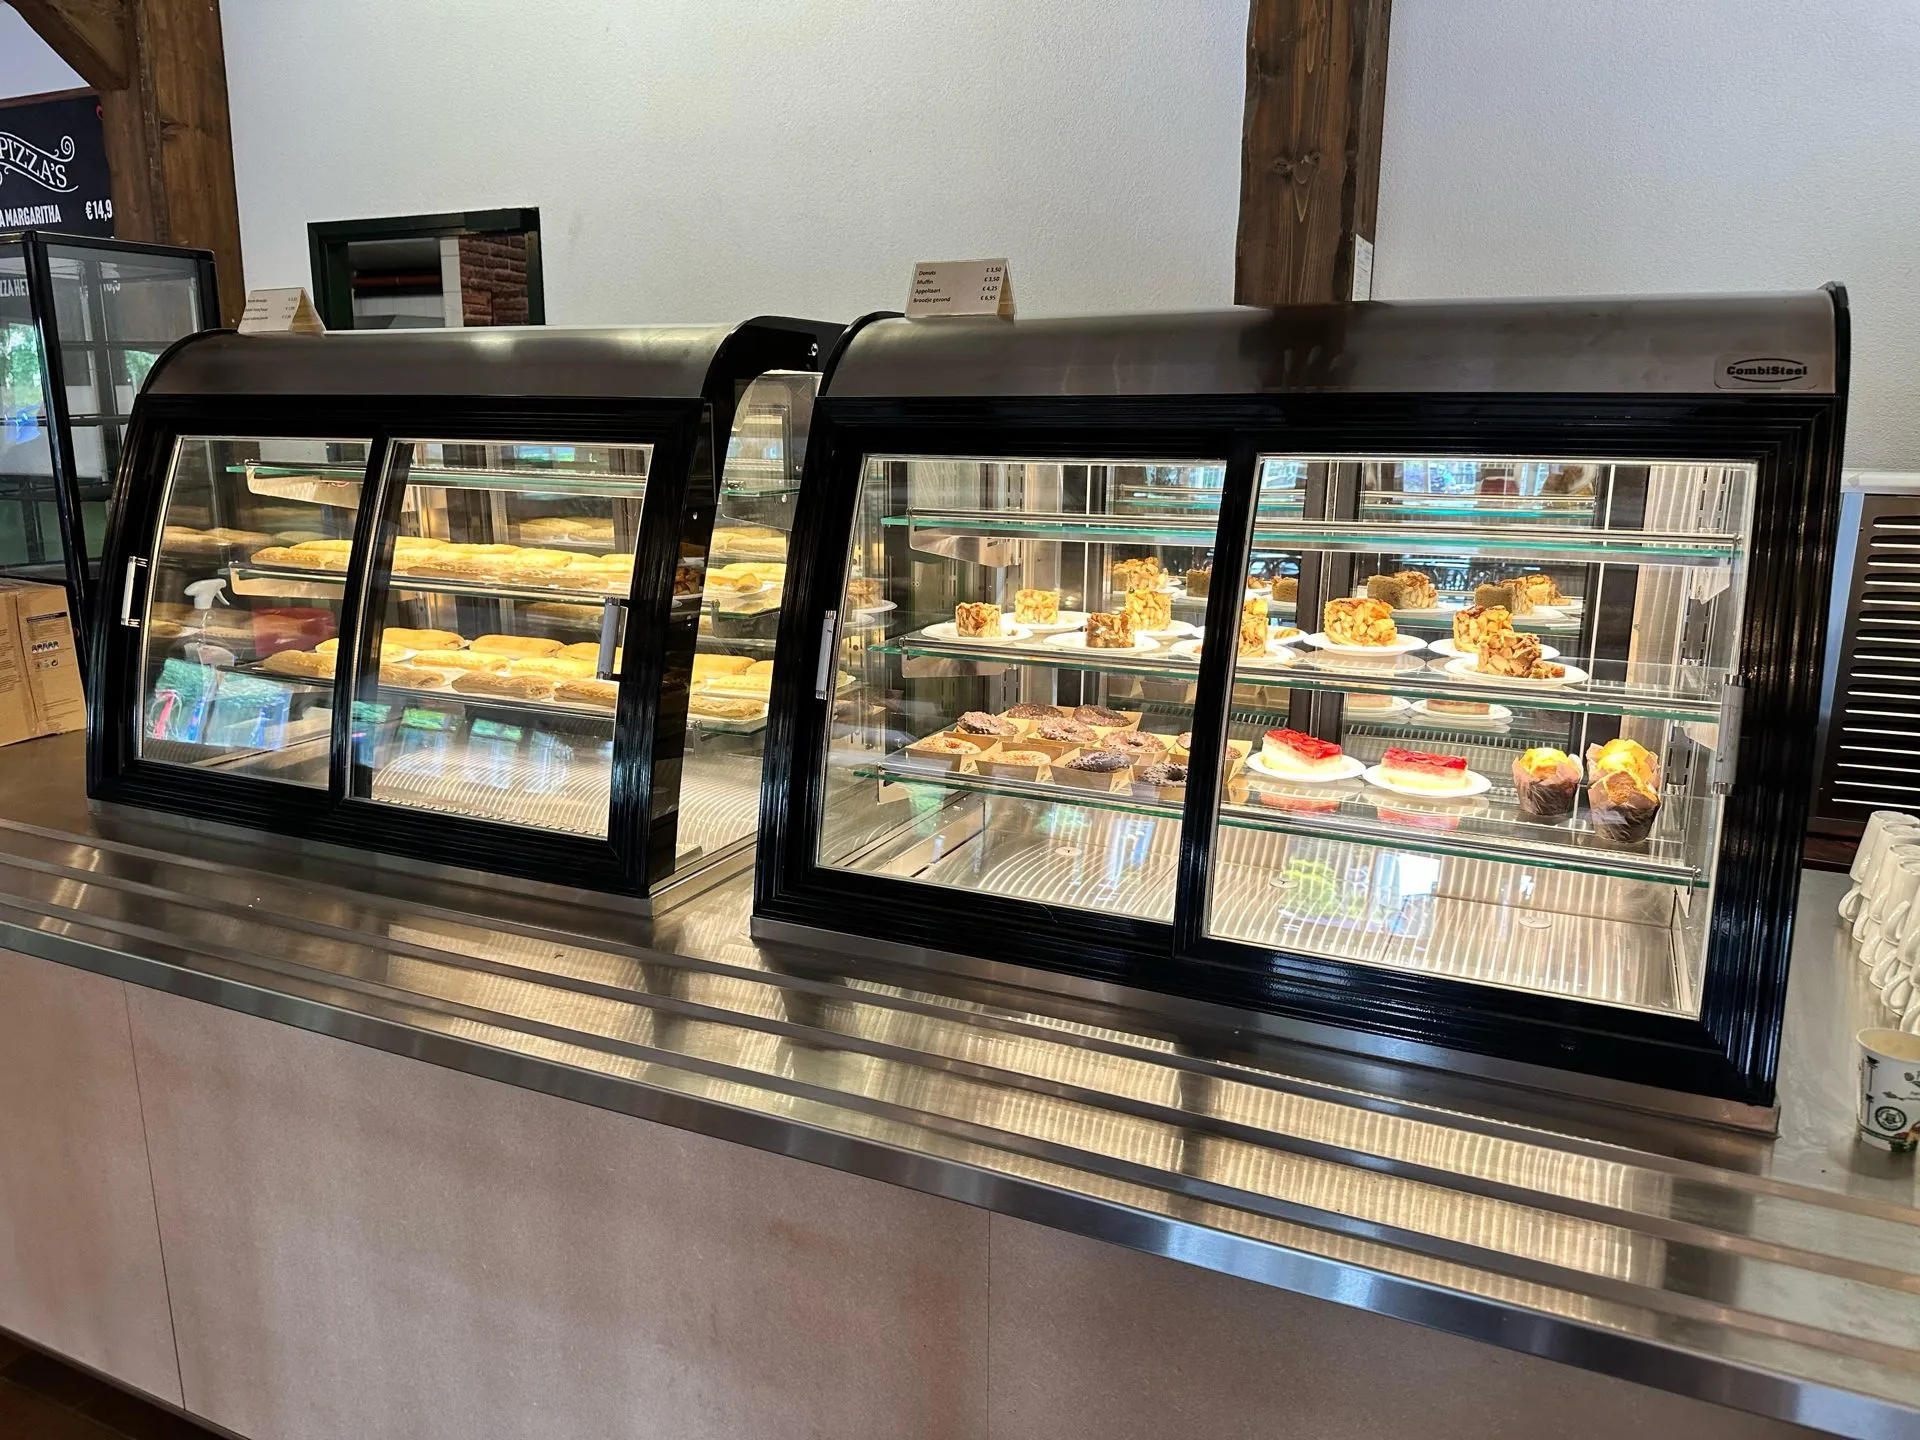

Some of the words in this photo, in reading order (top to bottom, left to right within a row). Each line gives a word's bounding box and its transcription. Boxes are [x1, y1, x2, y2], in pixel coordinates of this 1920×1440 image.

[0, 136, 67, 188] PIZZA'S
[5, 204, 62, 227] MARGARITHA
[1726, 366, 1808, 375] CombiSteel
